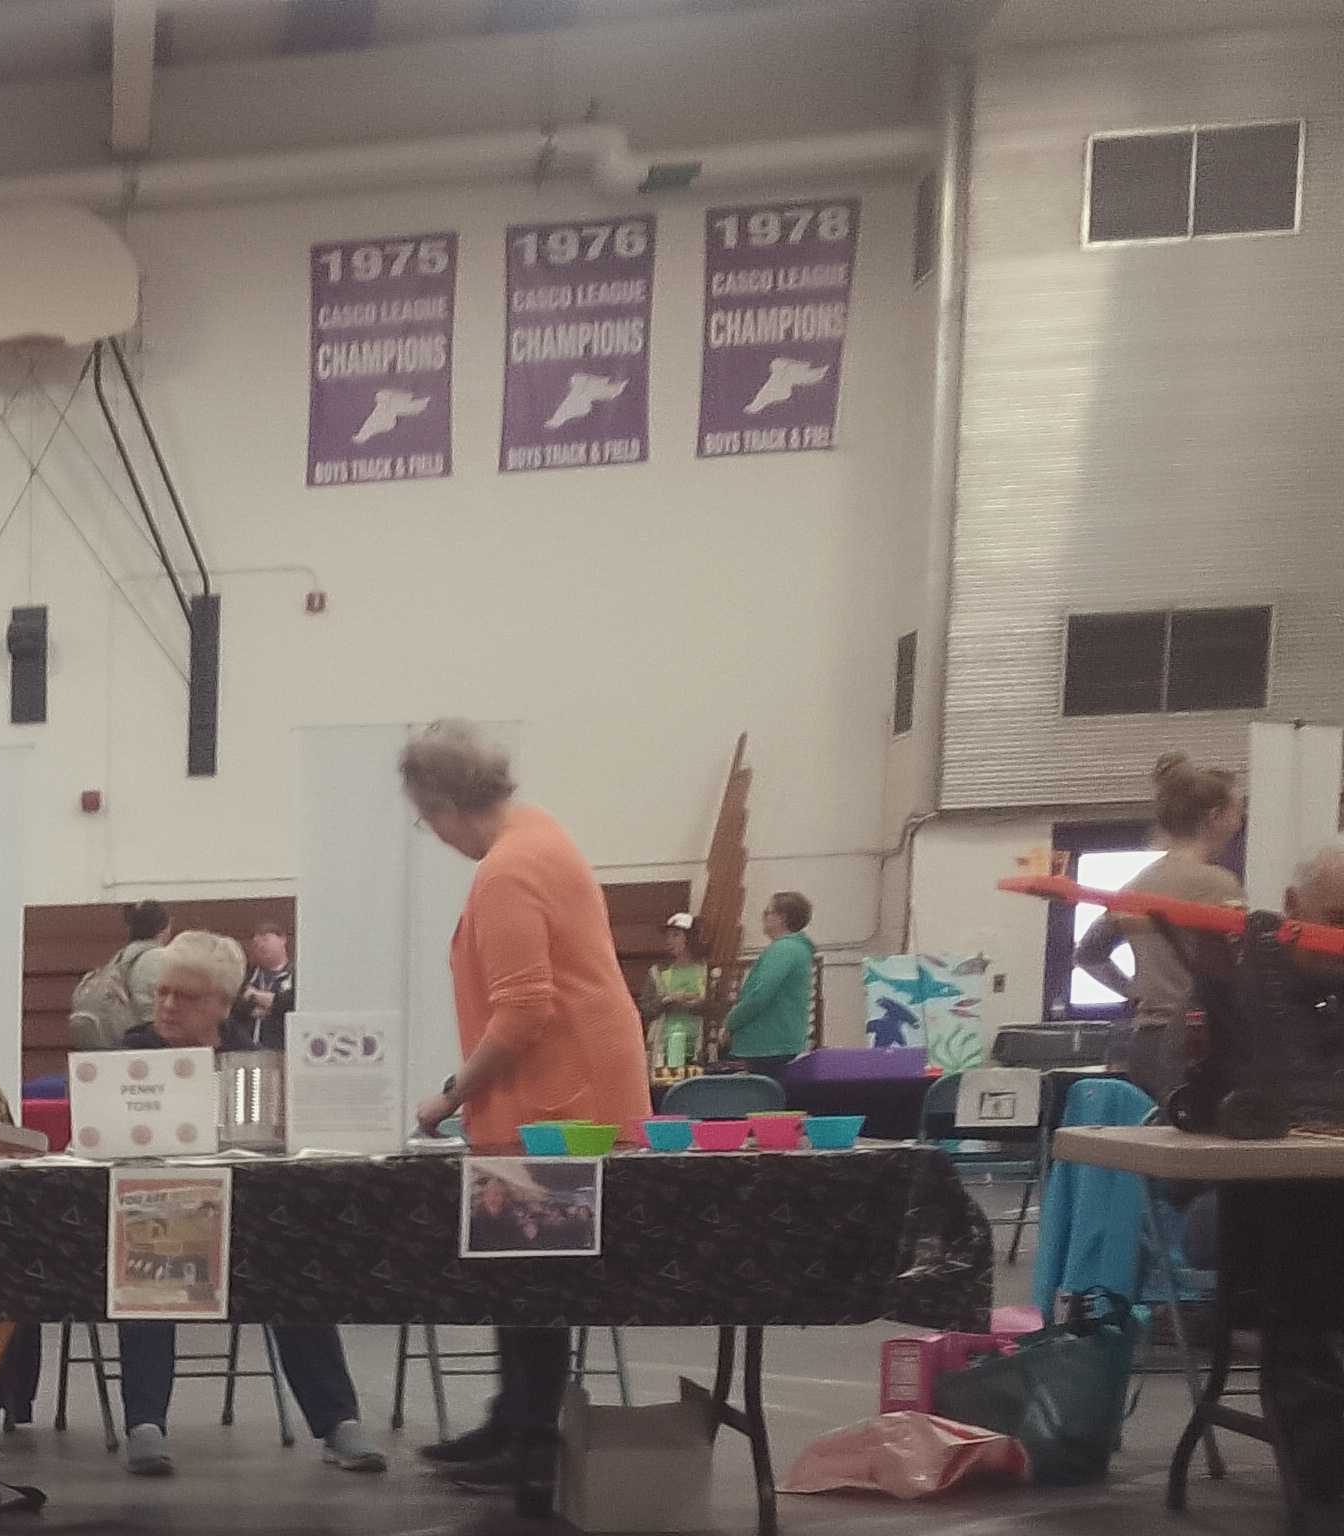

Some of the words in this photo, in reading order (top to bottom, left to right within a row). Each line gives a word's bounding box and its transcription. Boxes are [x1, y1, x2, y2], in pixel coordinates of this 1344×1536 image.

[515, 221, 647, 267] 1976
[714, 206, 850, 250] 1978
[319, 239, 448, 286] 1975
[711, 268, 772, 298] CASCO
[778, 262, 849, 293] LEAGUE
[318, 302, 376, 331] CASCO
[381, 296, 448, 325] LEAGUE
[513, 285, 570, 313] CASCO
[577, 279, 646, 309] LEAGUE
[512, 317, 644, 363] CHAMPIONS
[710, 301, 846, 349] CHAMPIONS
[318, 335, 447, 380] CHAMPIONS
[120, 1084, 165, 1096] PENNY
